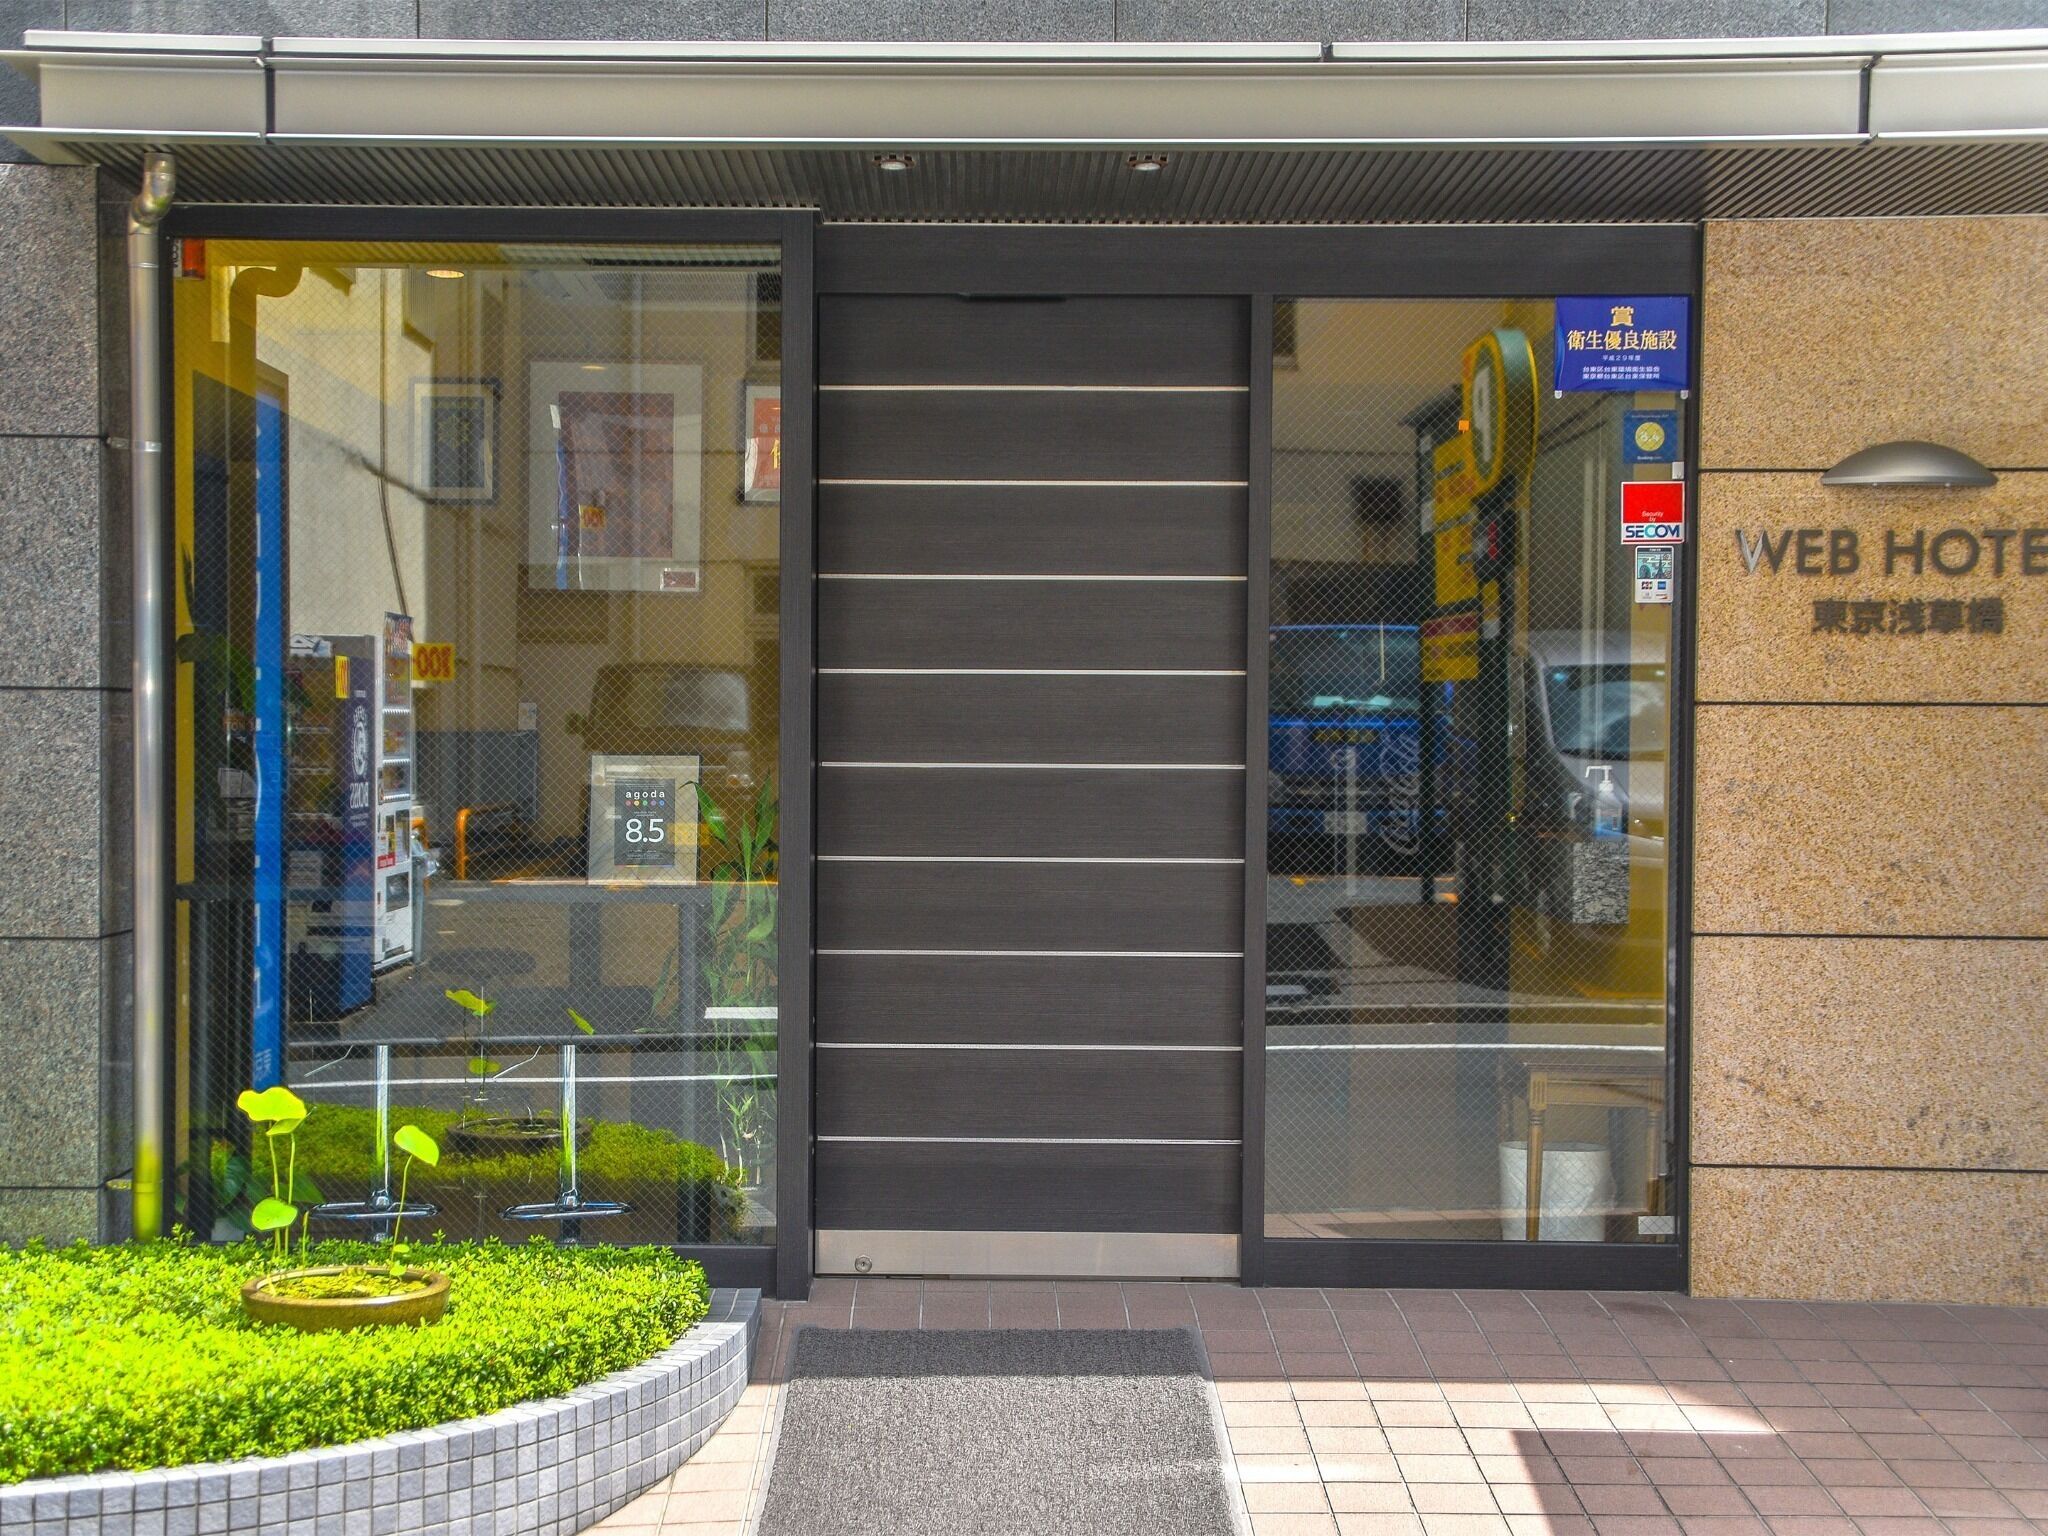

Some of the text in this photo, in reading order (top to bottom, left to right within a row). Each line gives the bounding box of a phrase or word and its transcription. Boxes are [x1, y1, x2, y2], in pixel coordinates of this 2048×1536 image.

[1611, 306, 1634, 327] 賞
[1567, 330, 1677, 350] 衛生優良施設
[1641, 510, 1664, 518] Security
[1626, 525, 1680, 538] SECOM
[1734, 528, 1861, 576] WEB
[1812, 598, 2005, 634] 東京浅草橋
[625, 790, 665, 800] agoda
[625, 818, 665, 843] 8.5
